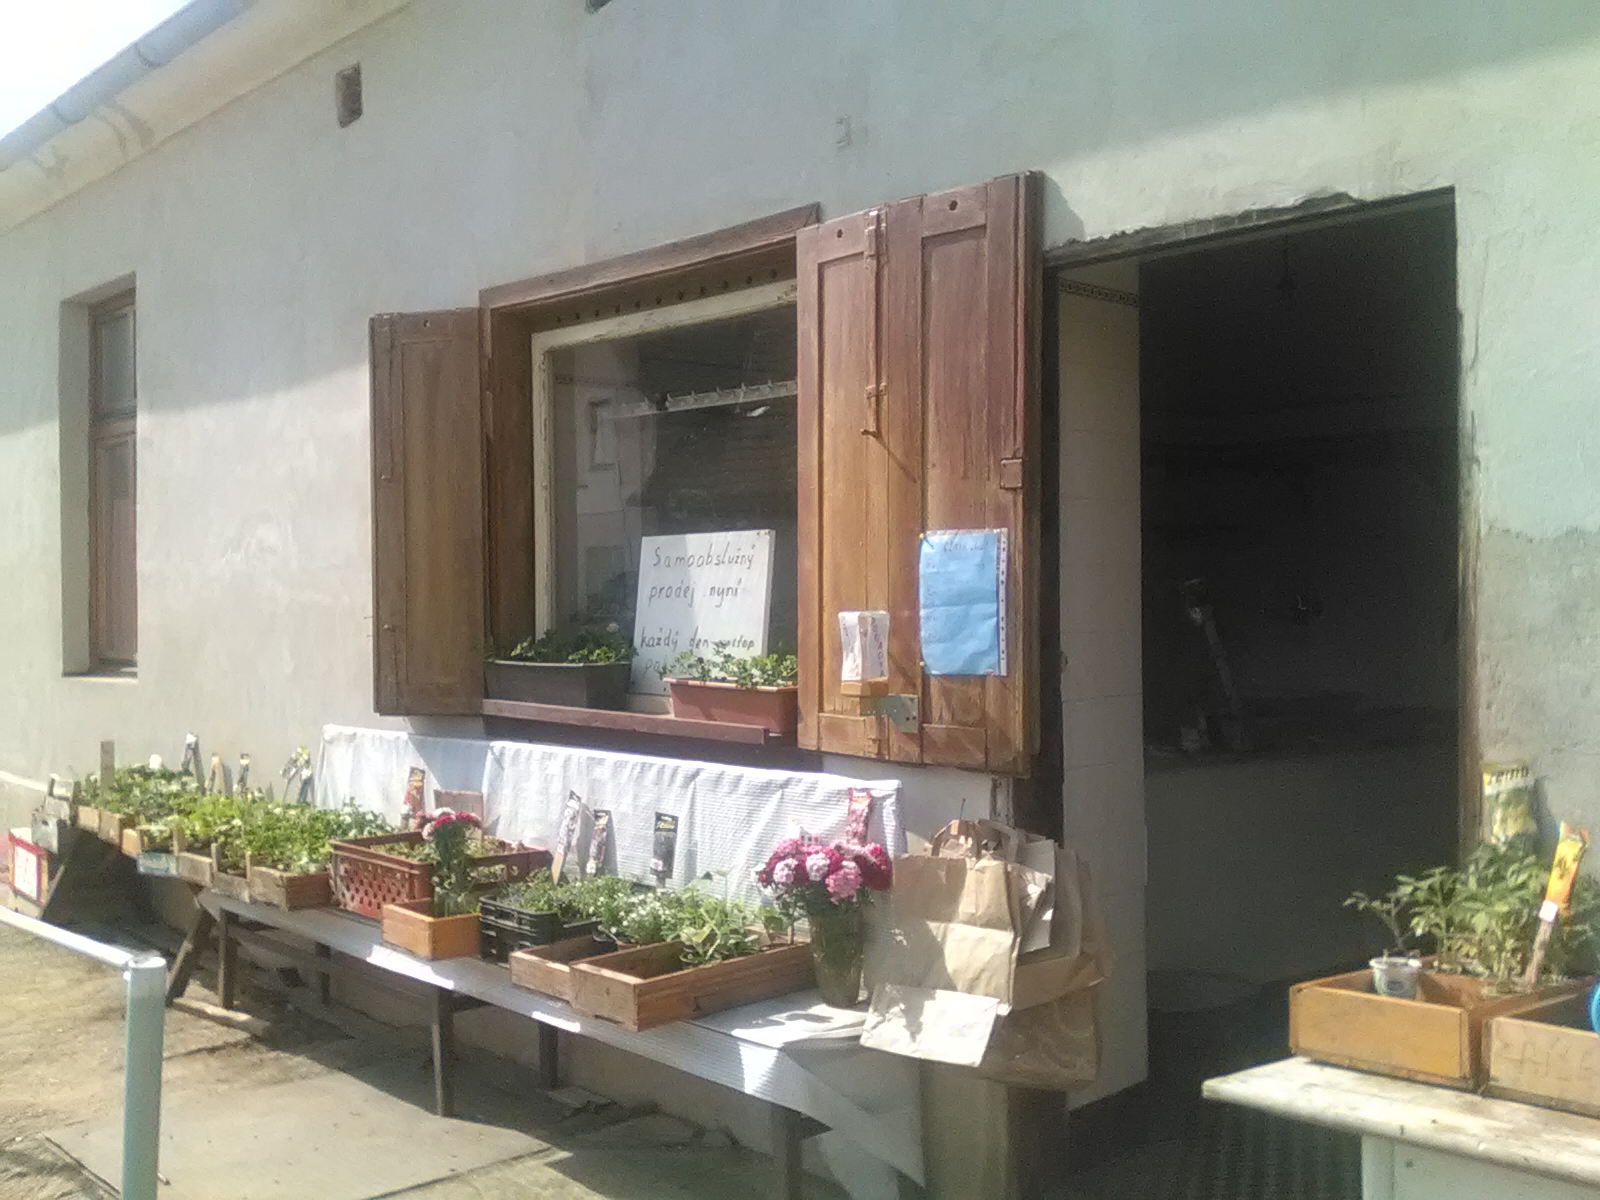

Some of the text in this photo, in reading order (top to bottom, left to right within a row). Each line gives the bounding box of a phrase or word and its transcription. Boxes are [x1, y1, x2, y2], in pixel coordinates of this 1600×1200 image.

[652, 542, 756, 570] Samoobslužný
[647, 579, 742, 608] prodej nyní
[639, 627, 680, 652] každý
[688, 626, 709, 649] den
